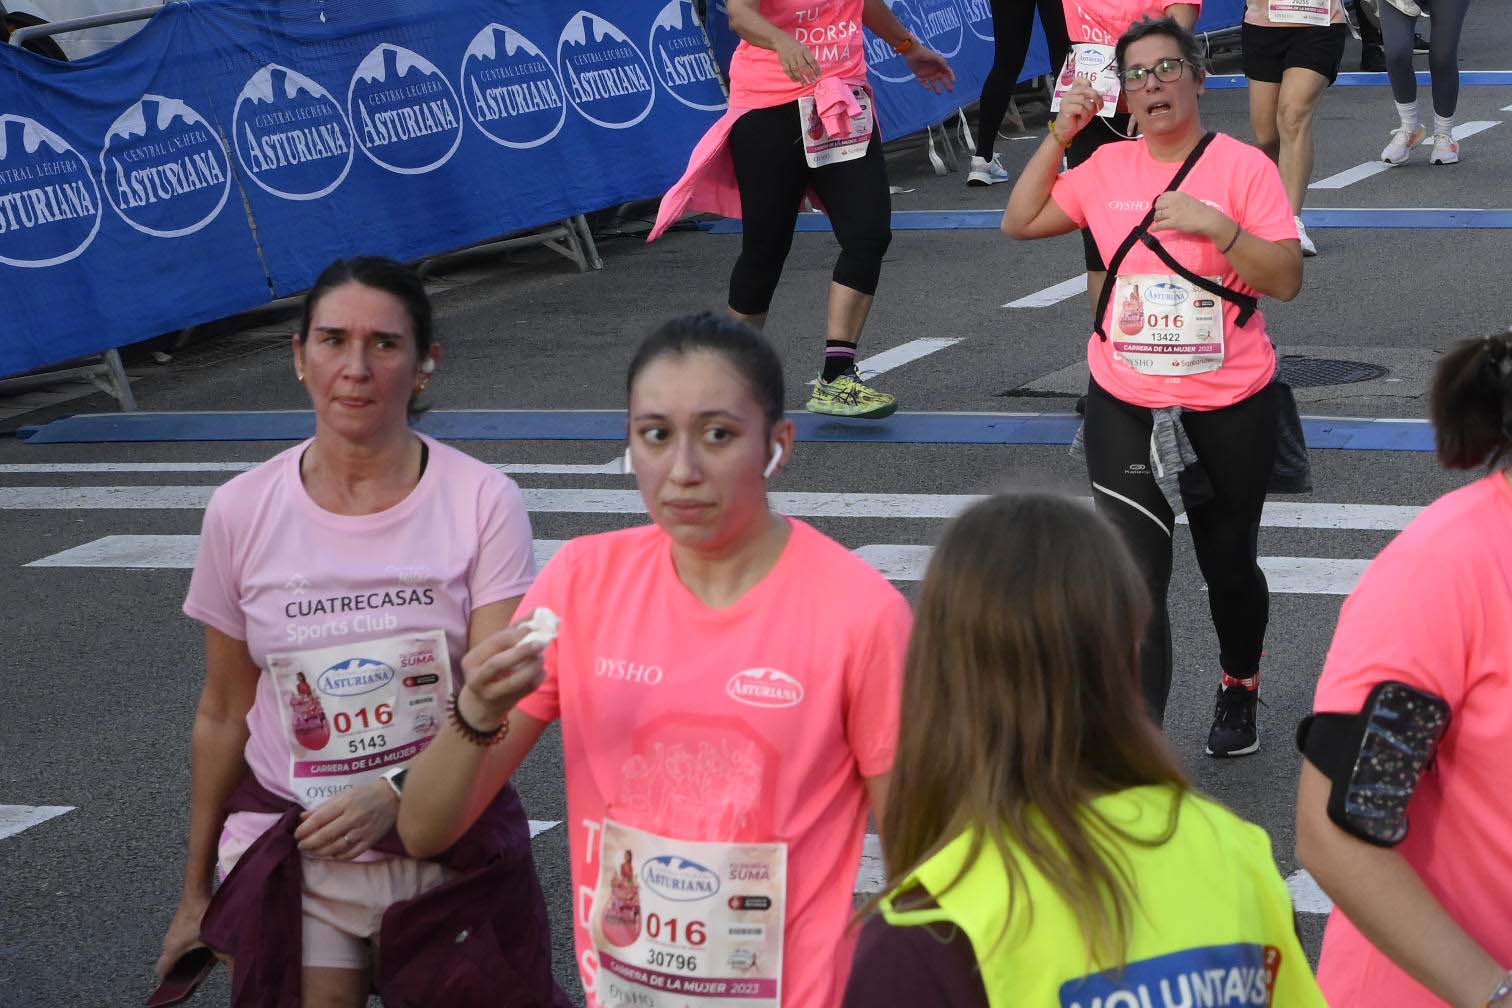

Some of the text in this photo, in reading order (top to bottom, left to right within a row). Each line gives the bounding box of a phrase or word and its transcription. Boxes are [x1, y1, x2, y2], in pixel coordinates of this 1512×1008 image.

[795, 8, 819, 23] TU
[795, 20, 859, 44] DORSA
[564, 58, 652, 104] ASTURIANA
[470, 73, 563, 123] ASTURIANA
[254, 111, 295, 129] CENTRAL
[358, 97, 459, 148] ASTURIANA
[244, 121, 348, 173] ASTURIANA
[1147, 314, 1184, 328] 016
[1123, 344, 1152, 352] CARRERA
[1173, 345, 1196, 353] MUJER
[1152, 333, 1180, 342] 13422
[285, 588, 435, 619] CUATRECASAS
[285, 613, 398, 644] Sports Club
[400, 654, 435, 667] SUMA
[595, 656, 663, 686] OYSHO
[321, 669, 389, 691] ASTURIANA
[732, 680, 797, 701] ASTURIANA
[333, 703, 393, 734] 016
[349, 734, 387, 753] 5143
[311, 747, 417, 773] CARRERA DE LA MUJER
[648, 868, 713, 893] ASTURIANA
[729, 868, 770, 880] SUMA
[646, 912, 707, 945] 016
[647, 948, 697, 971] 30796
[650, 974, 664, 985] DE
[666, 977, 681, 990] LA
[683, 979, 727, 993] MUJER
[730, 982, 760, 993] 2023
